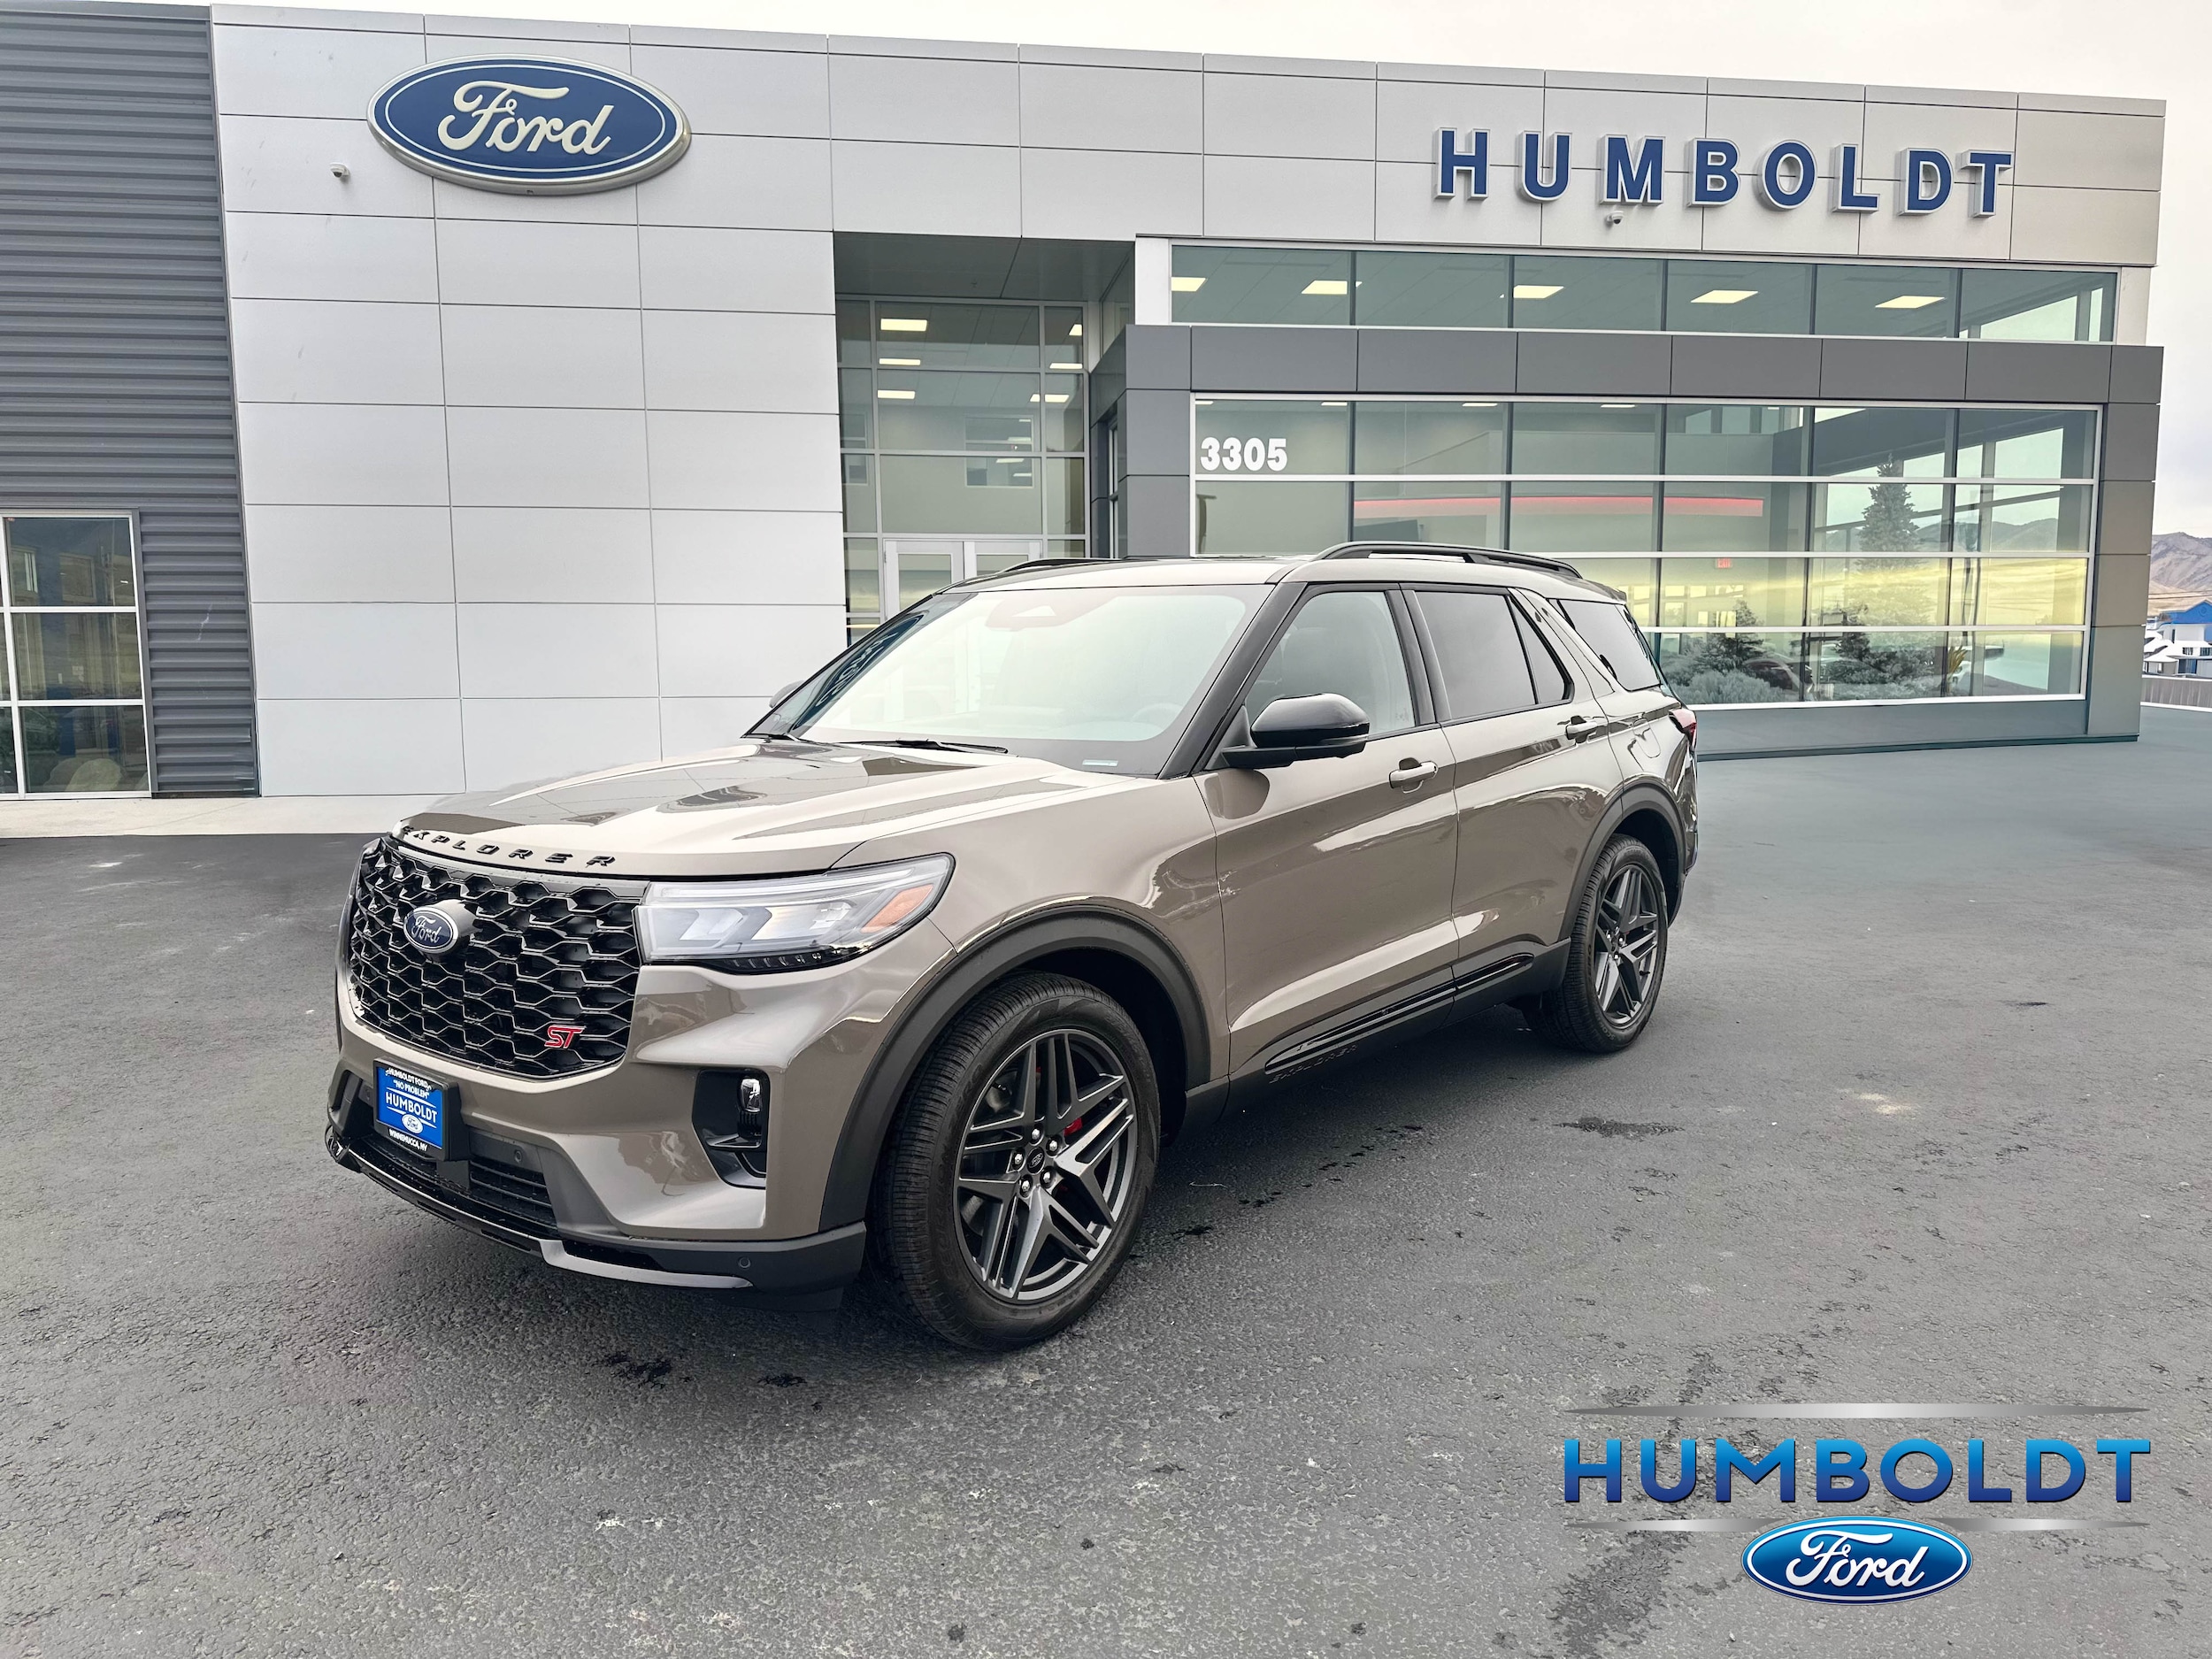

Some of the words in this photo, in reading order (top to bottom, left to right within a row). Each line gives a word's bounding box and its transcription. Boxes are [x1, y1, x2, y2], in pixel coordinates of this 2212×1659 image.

[437, 81, 614, 155] Ford
[1433, 127, 2014, 218] HUMBOLDT
[1201, 437, 1287, 471] 3305
[403, 826, 616, 868] EXPLORER
[411, 916, 442, 943] Ford
[544, 1025, 585, 1048] ST
[388, 1068, 415, 1084] HUMBOLDT
[414, 1078, 428, 1089] FORD
[385, 1091, 438, 1123] HUMBOLDT
[407, 1117, 419, 1130] Ford
[419, 1142, 427, 1151] NV
